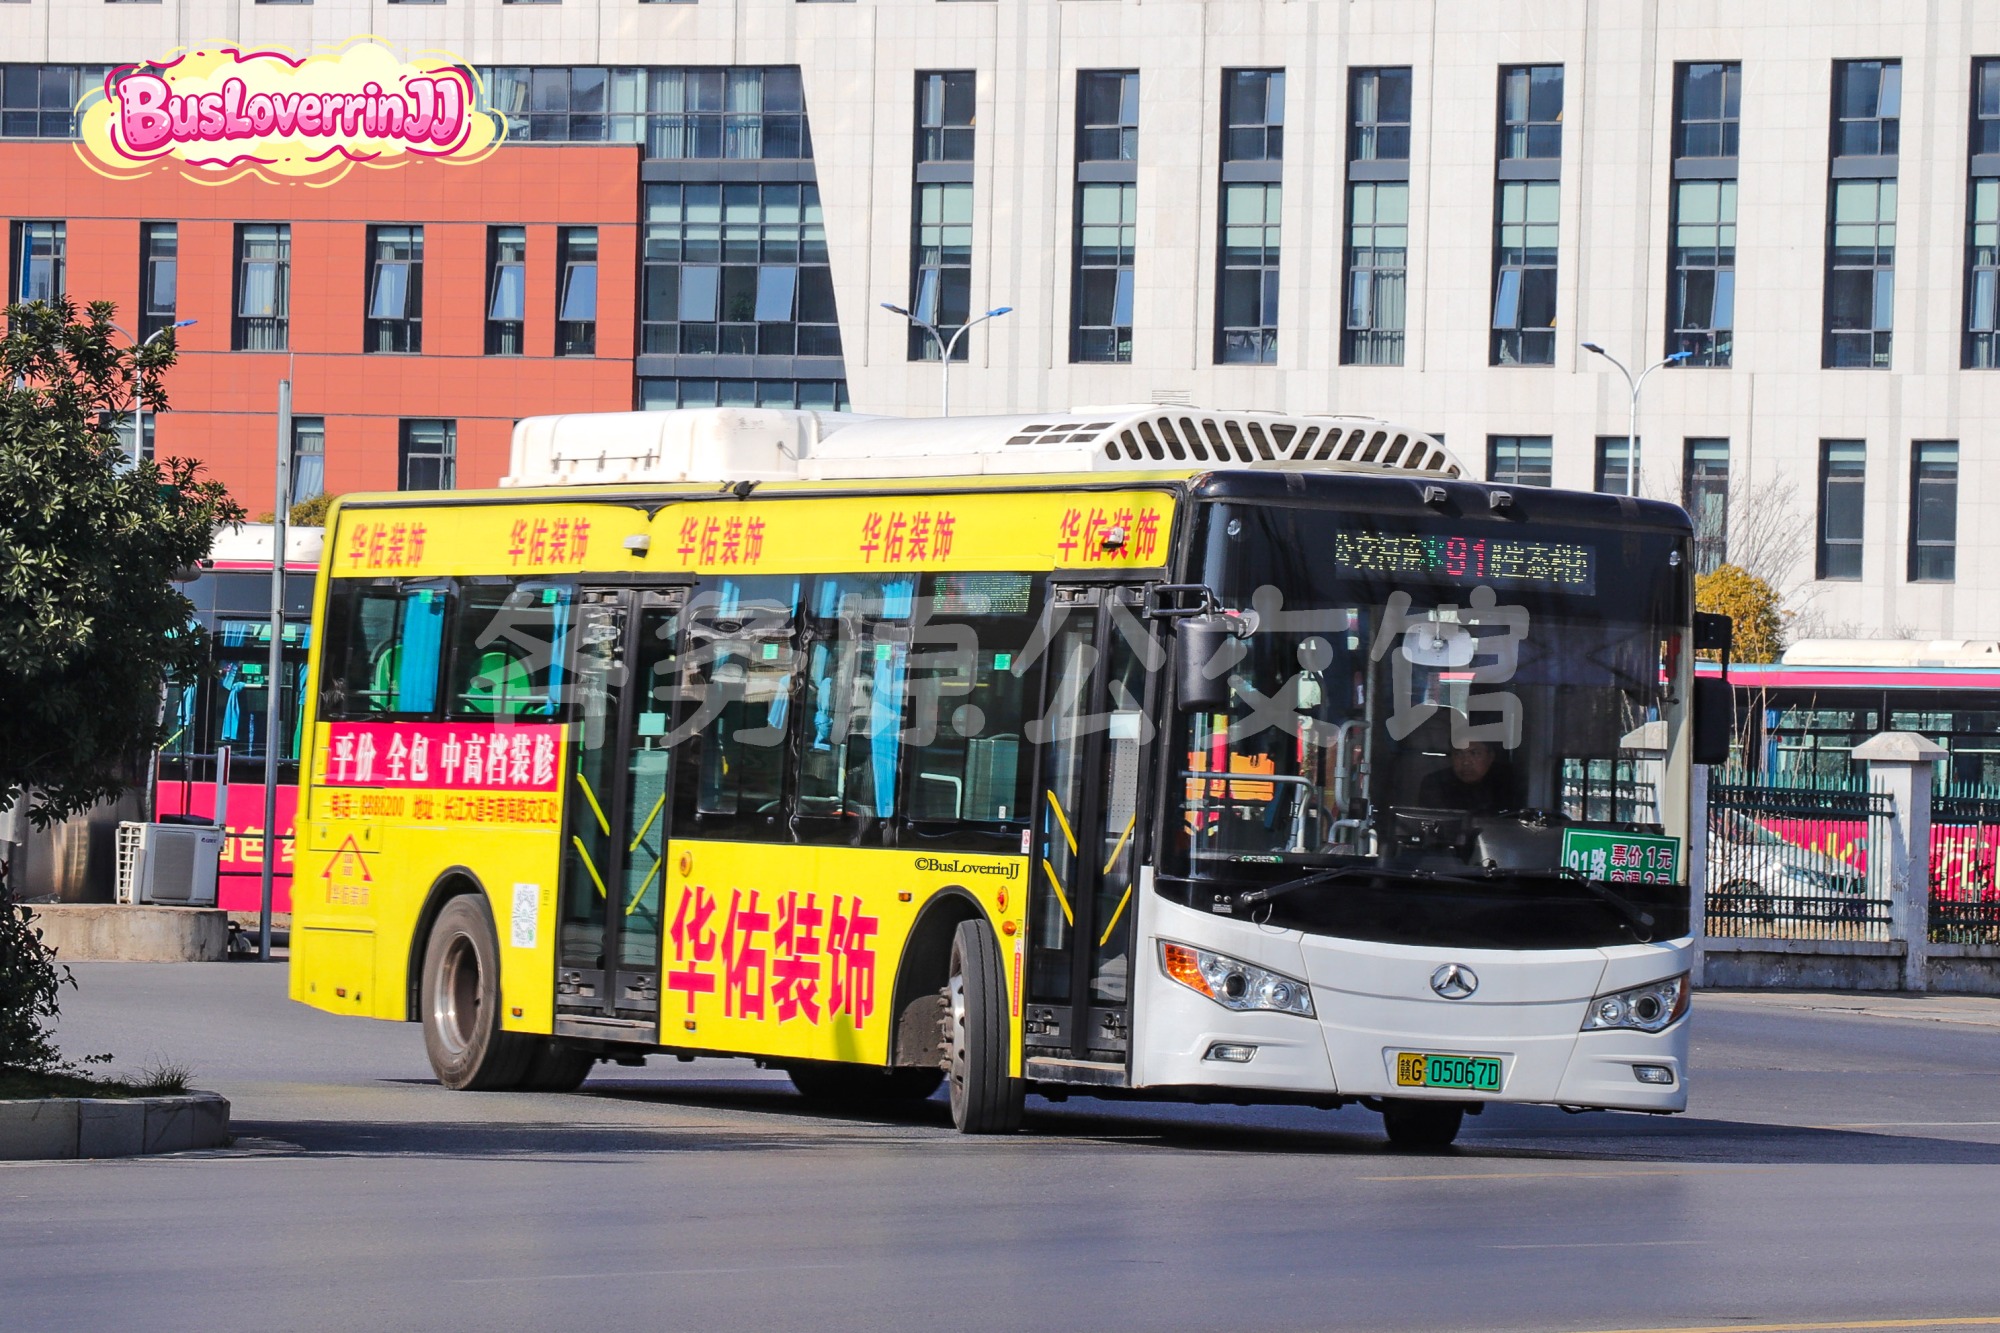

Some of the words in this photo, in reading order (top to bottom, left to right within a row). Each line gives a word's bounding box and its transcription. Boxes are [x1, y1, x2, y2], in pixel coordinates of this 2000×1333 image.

[349, 523, 427, 569] 华佑装饰
[509, 517, 590, 566] 华佑装饰
[677, 516, 765, 565] 华佑装饰
[860, 511, 956, 563] 华佑装饰
[1058, 508, 1160, 562] 华佑装饰
[1447, 537, 1485, 577] 91
[385, 732, 429, 782] 全包
[440, 732, 555, 785] 中高档装修
[667, 885, 879, 1030] 华佑装饰
